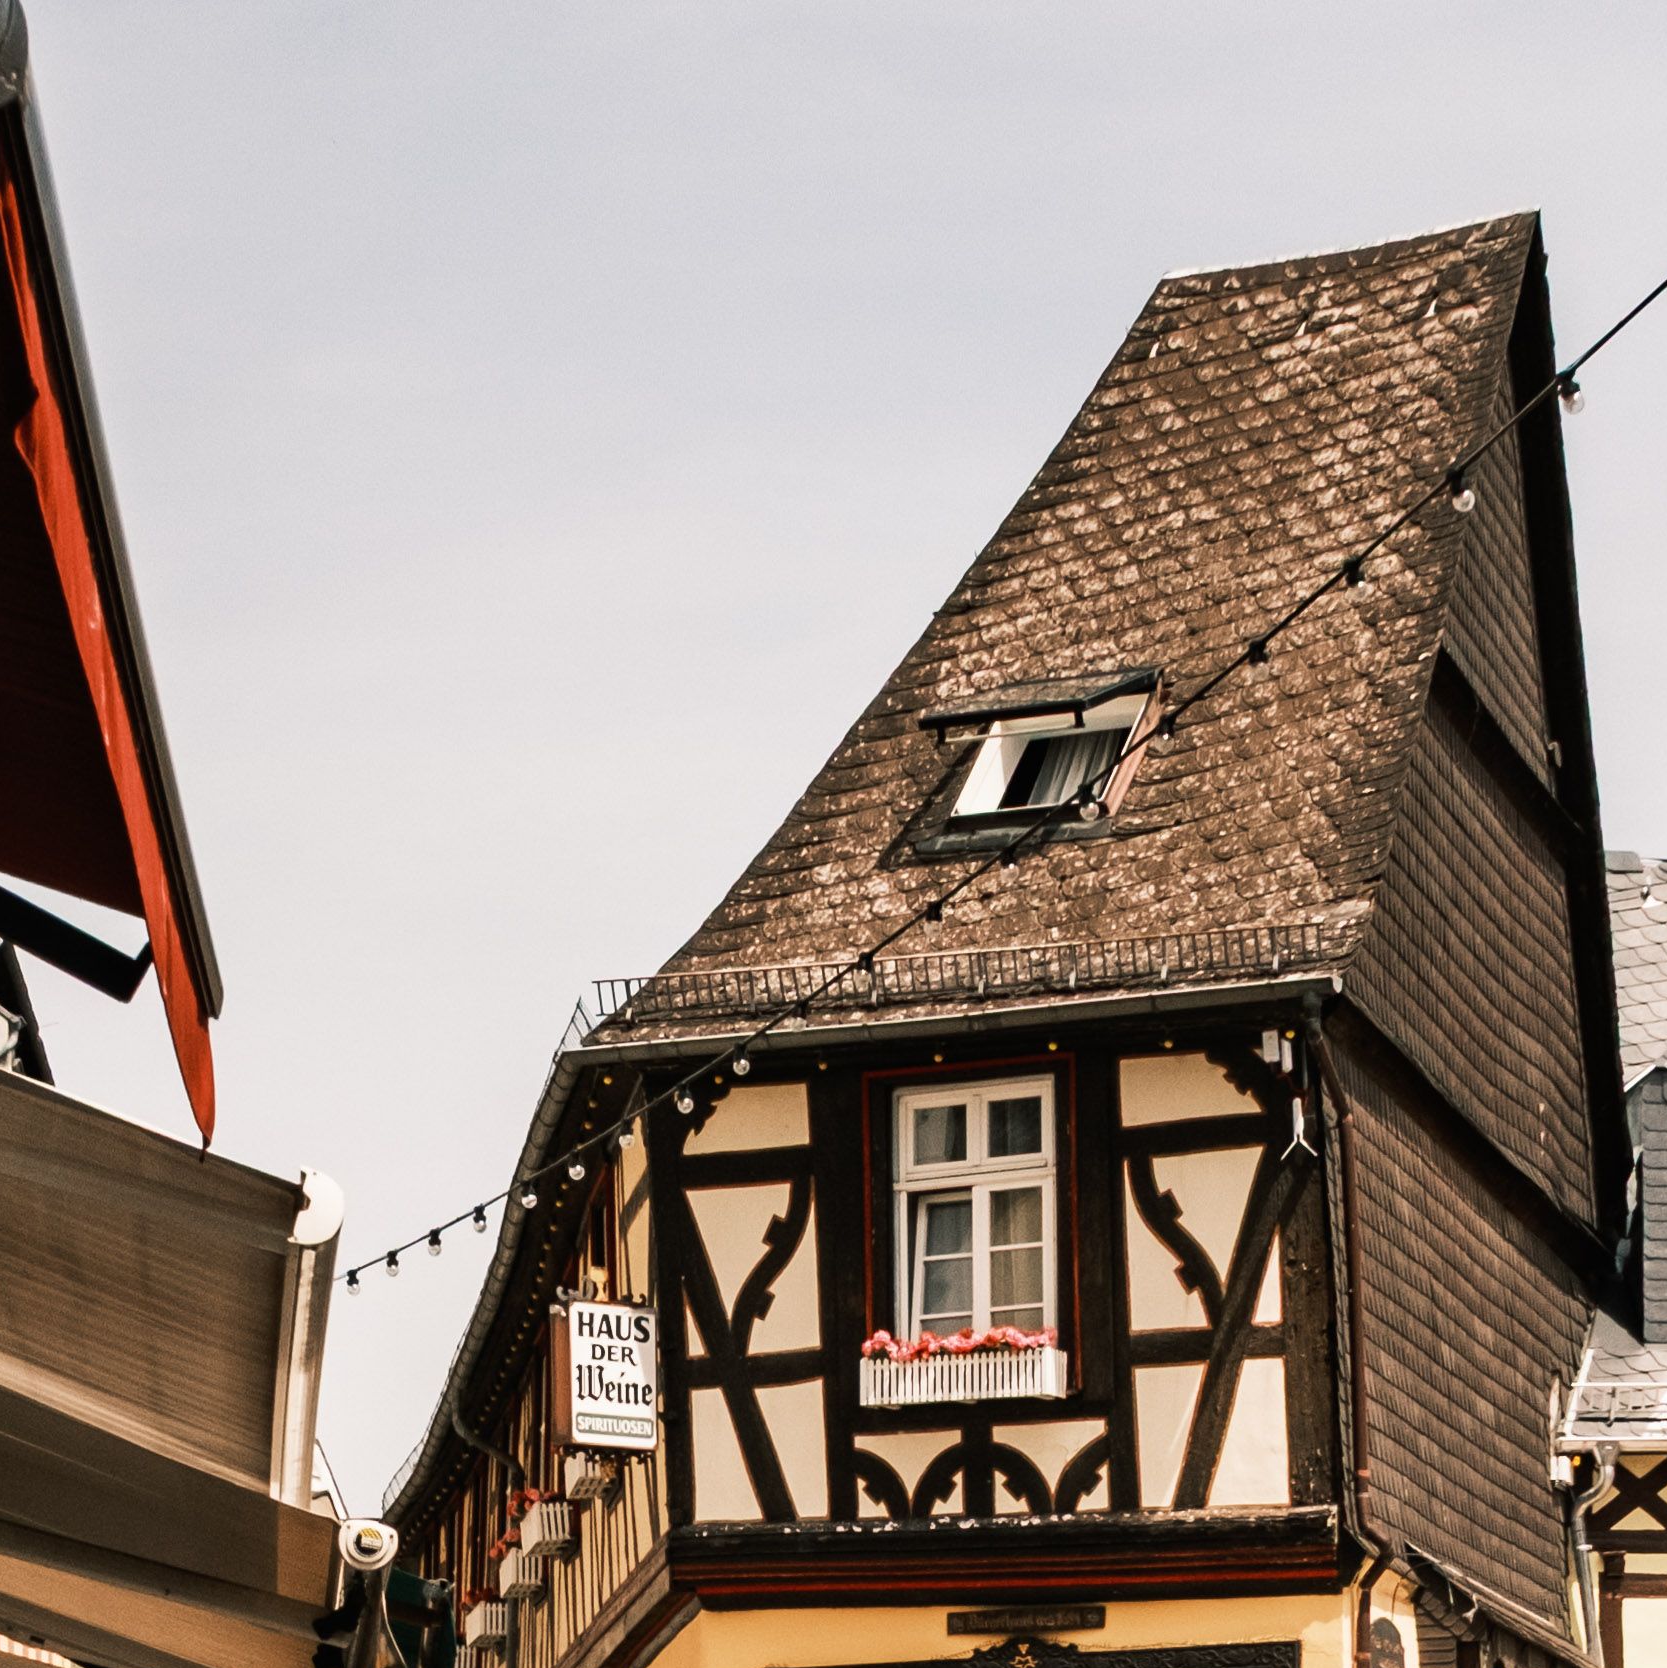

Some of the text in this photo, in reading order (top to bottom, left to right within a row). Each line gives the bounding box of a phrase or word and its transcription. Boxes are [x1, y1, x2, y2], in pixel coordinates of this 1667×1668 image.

[577, 1311, 651, 1343] HAUS
[591, 1344, 638, 1366] DER
[575, 1364, 653, 1406] Weine
[577, 1416, 652, 1436] SPIRITUOSEN
